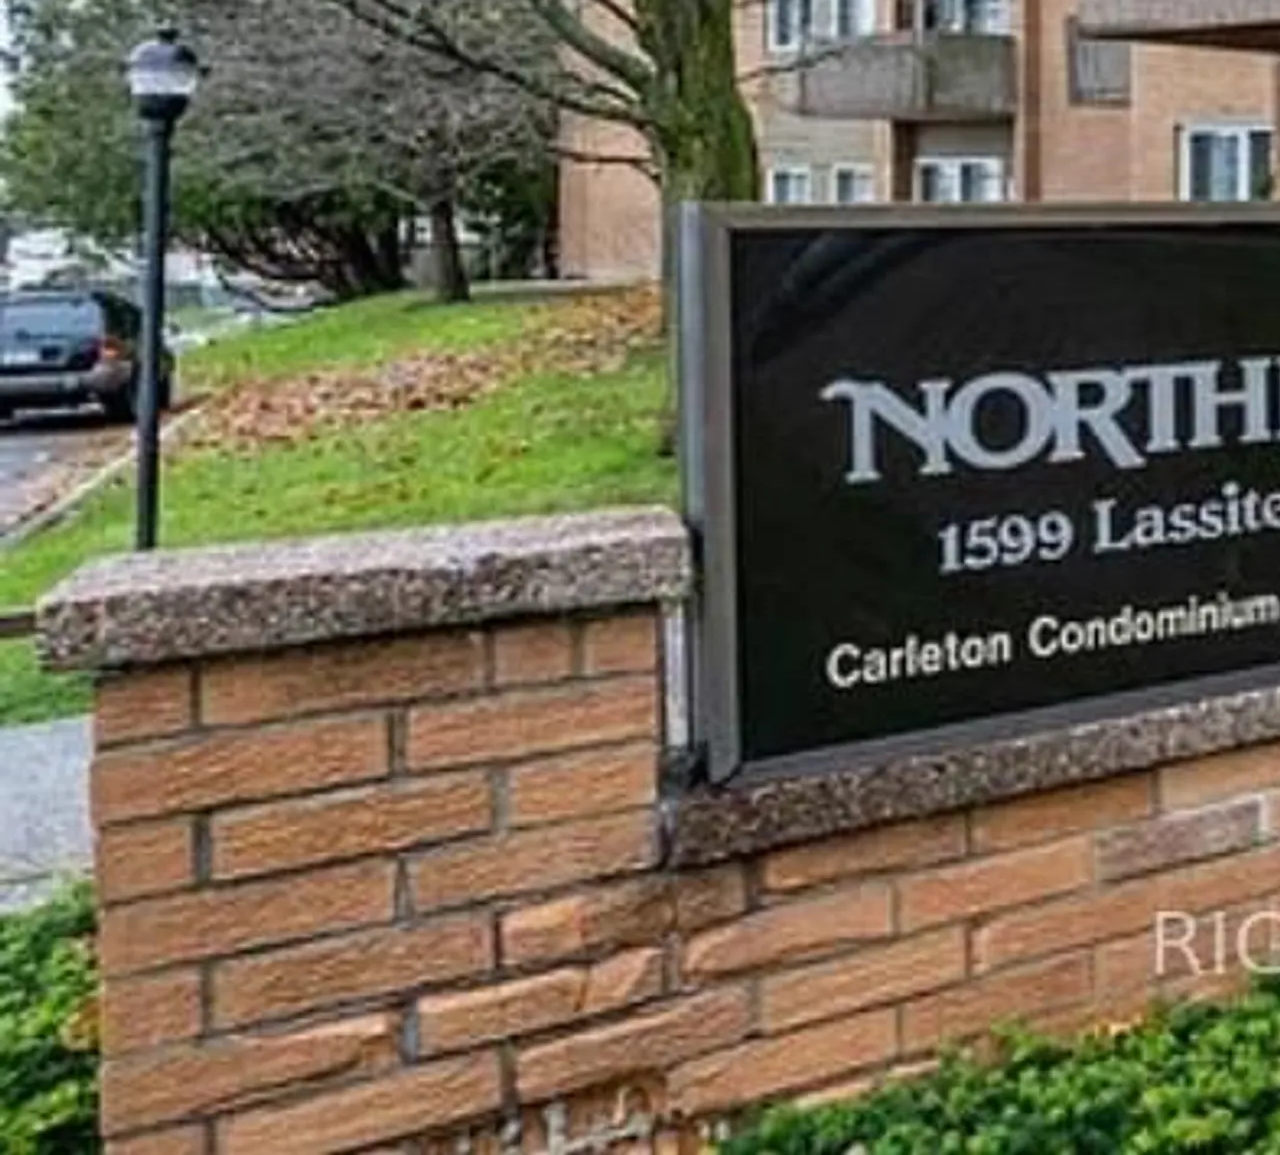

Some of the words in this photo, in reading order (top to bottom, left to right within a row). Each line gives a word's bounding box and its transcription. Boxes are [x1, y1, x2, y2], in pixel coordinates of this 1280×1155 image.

[937, 509, 1074, 574] 1599
[826, 625, 1011, 688] Carleton
[1028, 590, 1280, 658] Condominium
